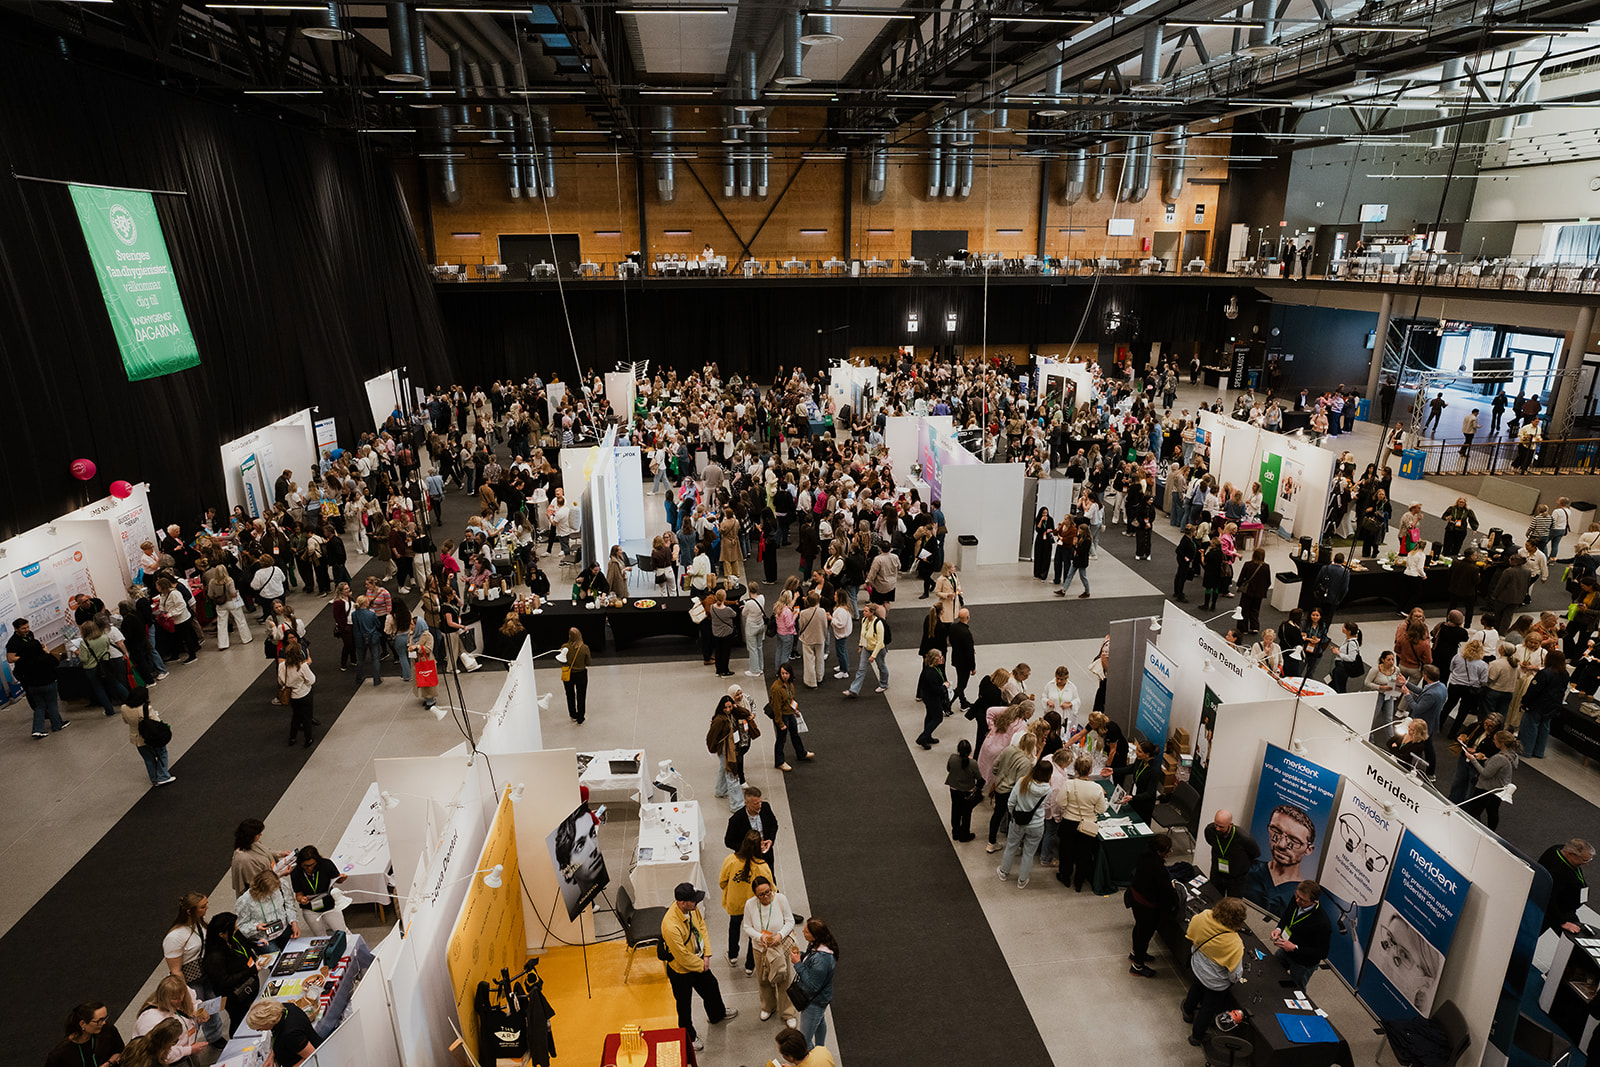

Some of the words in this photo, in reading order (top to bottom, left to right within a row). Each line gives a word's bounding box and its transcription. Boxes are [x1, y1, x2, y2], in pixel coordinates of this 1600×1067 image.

[115, 249, 150, 263] Sveriges
[106, 264, 168, 279] Tandhygienister
[136, 295, 150, 309] dig
[134, 322, 180, 342] DAGARNA
[1234, 352, 1245, 388] SPECIALKOST
[1150, 654, 1170, 678] GAMA
[1198, 637, 1218, 658] Gama
[1219, 652, 1243, 678] Dental
[1283, 757, 1320, 778] merident
[1307, 782, 1317, 791] det
[1367, 764, 1420, 814] Merident
[1352, 795, 1390, 832] merident
[1409, 848, 1458, 895] merident
[1401, 867, 1411, 879] Där
[1410, 877, 1436, 902] precision
[1435, 900, 1454, 918] möter
[1426, 900, 1447, 922] design.
